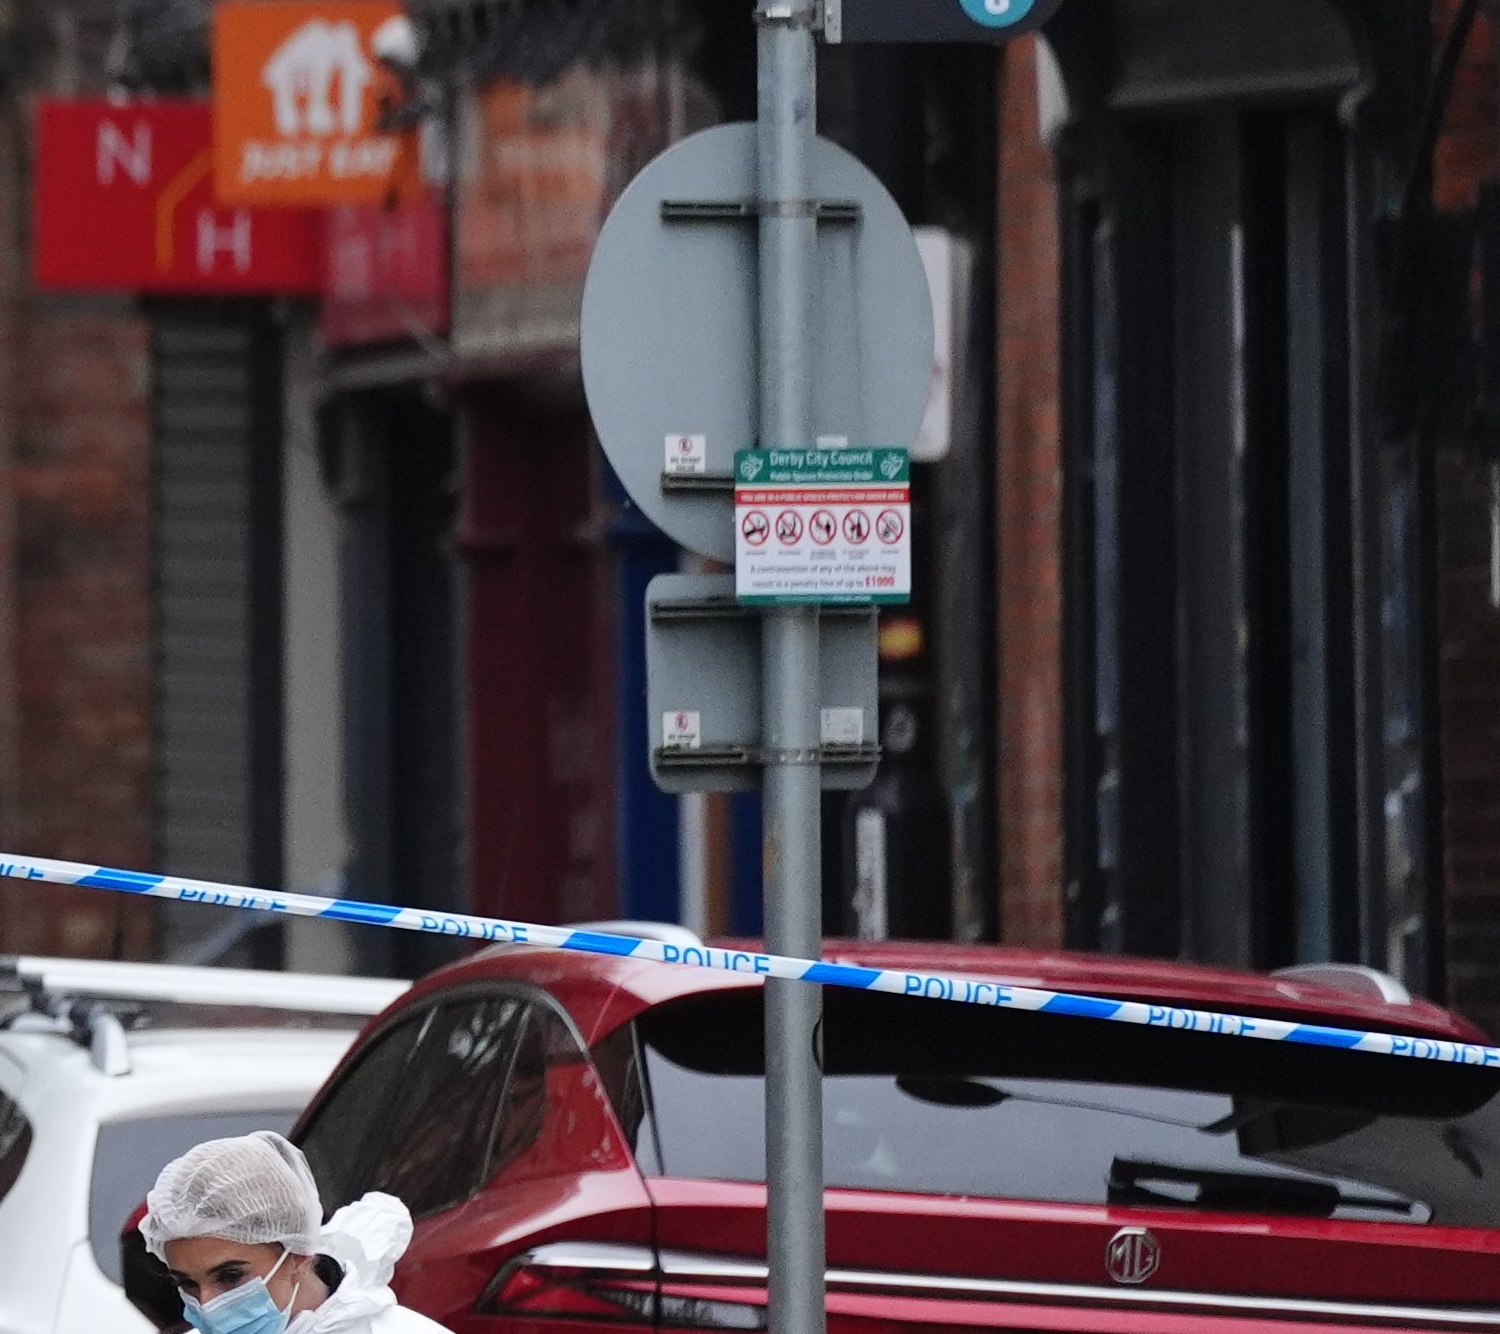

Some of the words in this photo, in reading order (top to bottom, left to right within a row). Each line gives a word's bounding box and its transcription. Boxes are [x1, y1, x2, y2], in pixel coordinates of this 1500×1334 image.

[240, 138, 321, 184] JUST
[329, 135, 398, 179] EAT
[769, 450, 804, 468] Derby
[806, 451, 830, 468] City
[830, 450, 874, 466] Council
[420, 916, 529, 943] POLICE
[662, 943, 771, 975] POLICE
[904, 973, 1014, 1005] POLICE
[1148, 1004, 1258, 1036] POLICE
[1391, 1036, 1500, 1067] POLICE
[1110, 1234, 1158, 1282] MG
